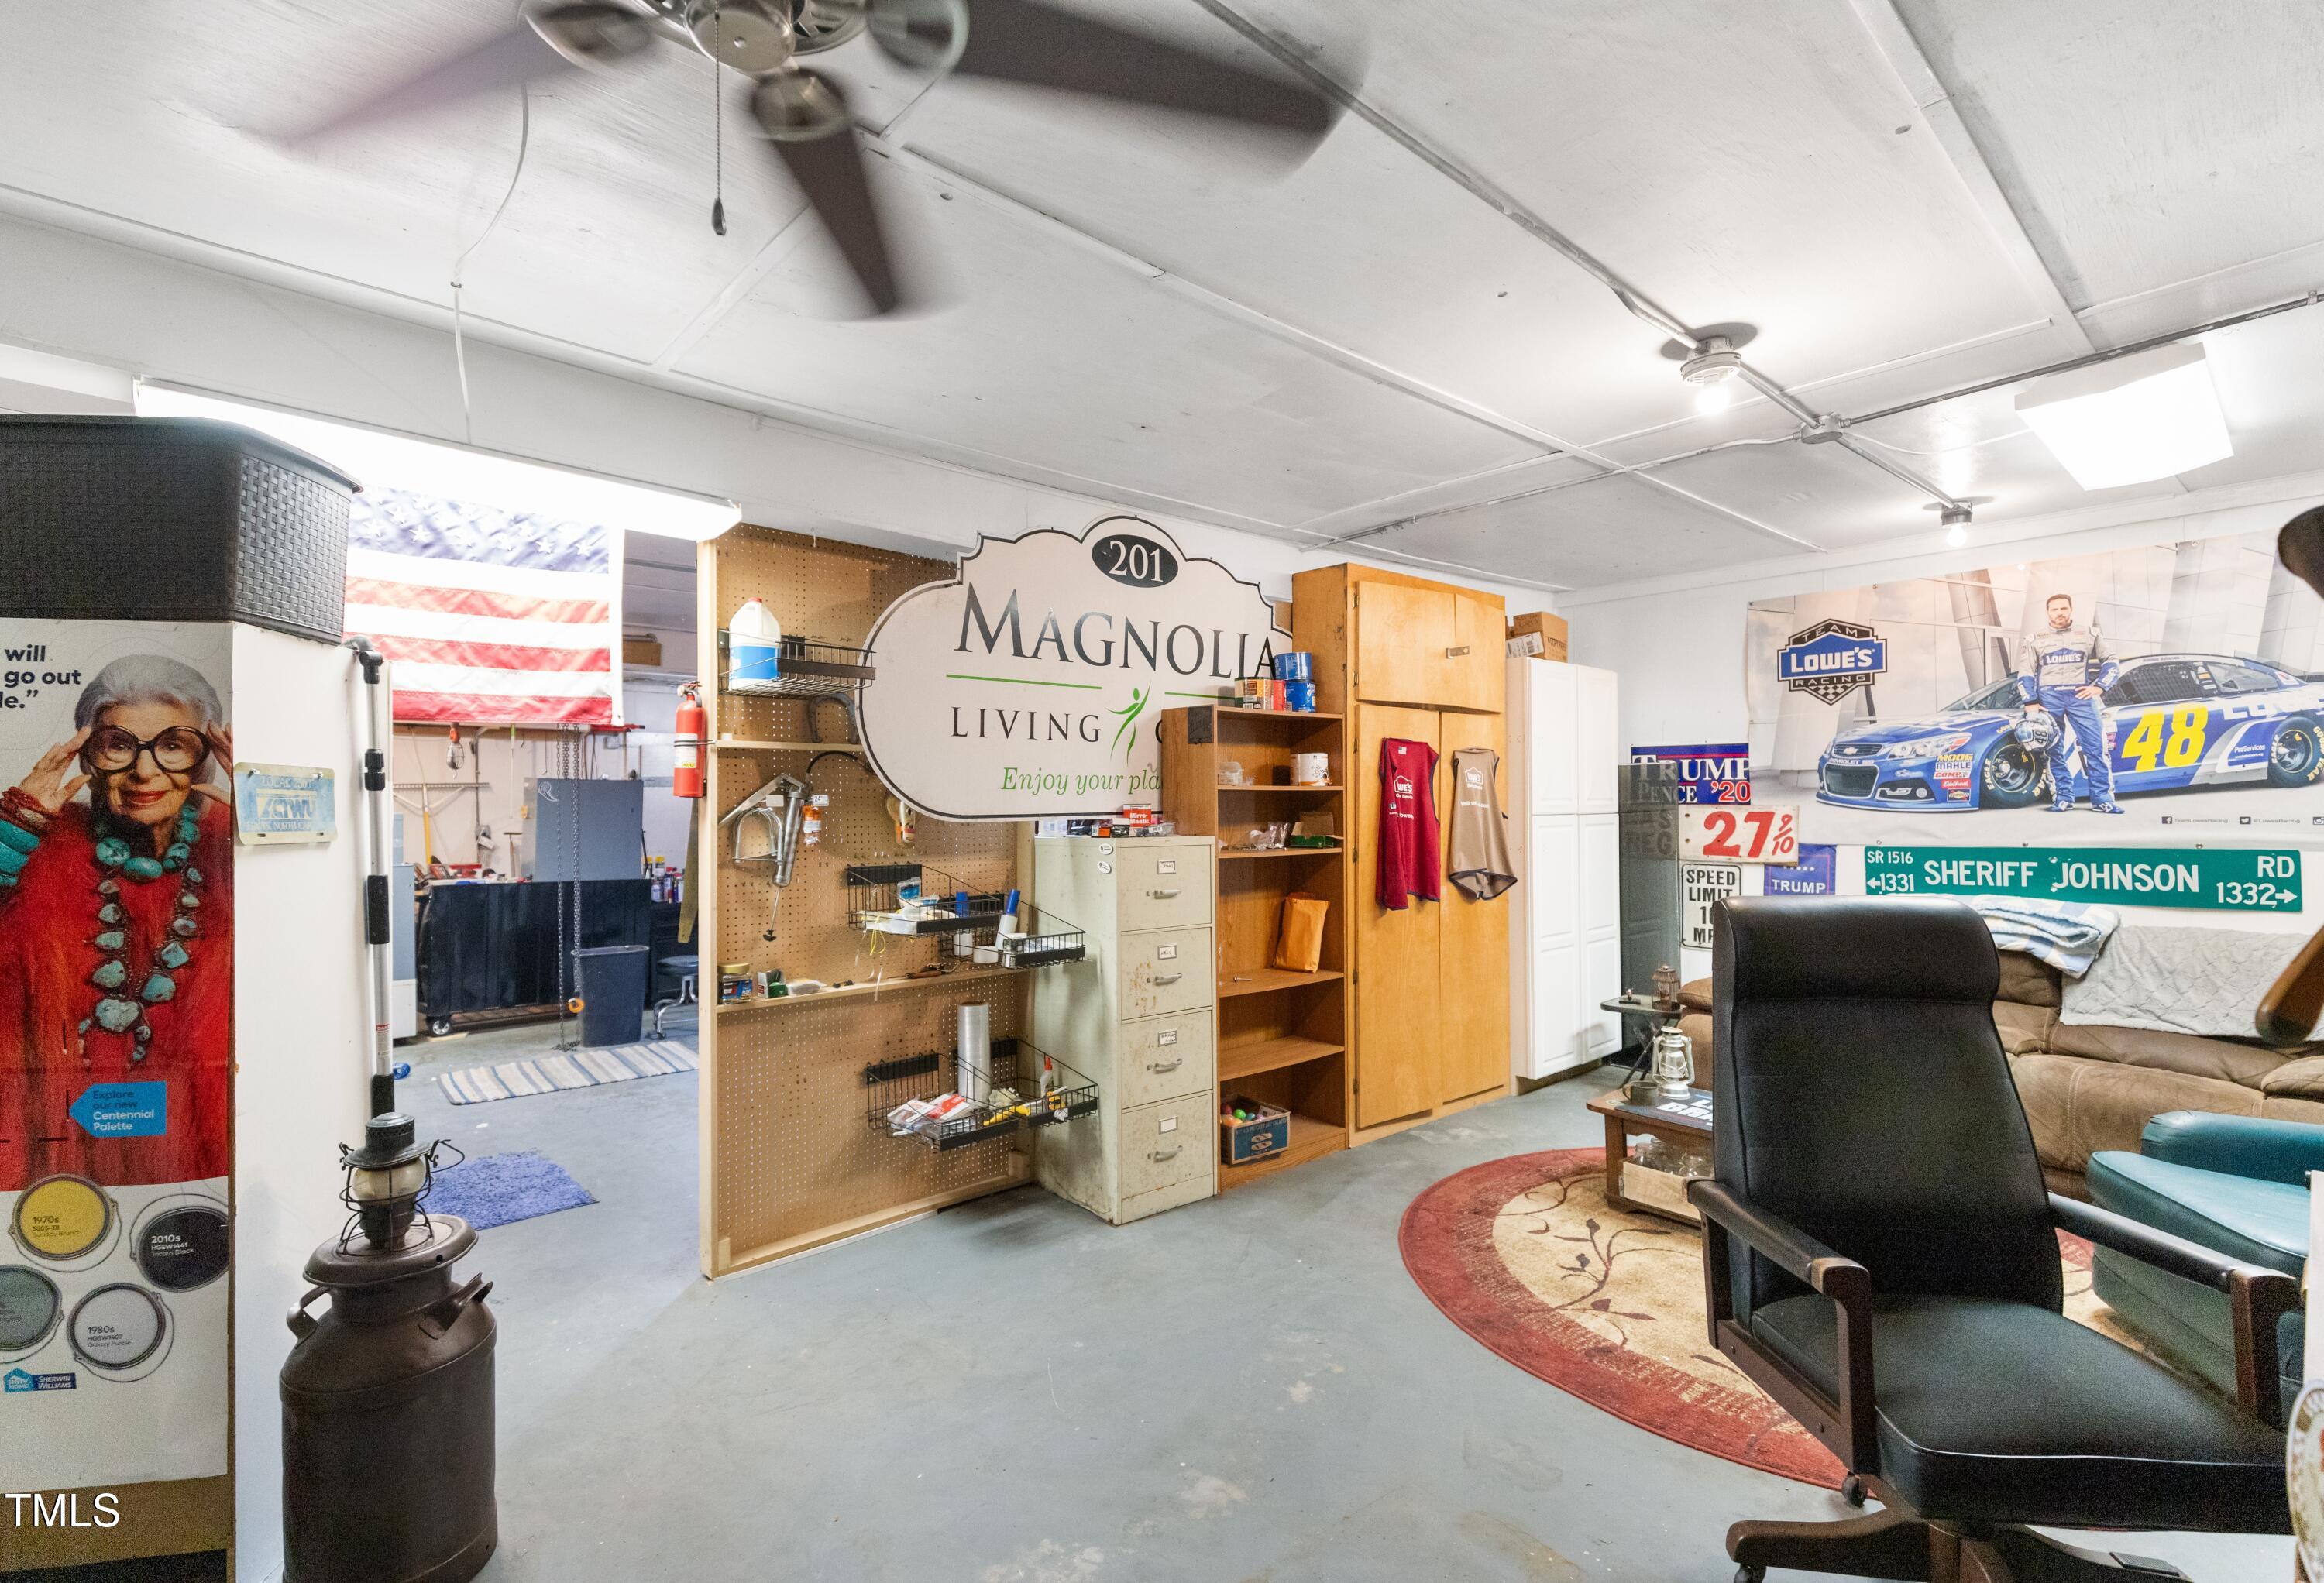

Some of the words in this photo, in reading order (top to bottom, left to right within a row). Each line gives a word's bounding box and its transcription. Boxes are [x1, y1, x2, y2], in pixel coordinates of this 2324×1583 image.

[1109, 540, 1164, 583] 201
[953, 582, 1277, 679] MAGNOLIA
[1801, 624, 1858, 642] TEAM
[5, 644, 46, 662] will
[1790, 646, 1873, 673] LOWE'S
[2045, 652, 2082, 664] LOWE'S
[4, 671, 36, 688] go
[41, 669, 81, 685] out
[1795, 674, 1866, 687] RACING
[951, 706, 1102, 743] LIVING
[2121, 702, 2209, 773] 48
[1631, 755, 1749, 782] TRUMP
[1001, 767, 1068, 795] Enjoy
[1075, 774, 1124, 795] your
[1127, 769, 1163, 795] pla
[1703, 810, 1776, 858] 27
[1866, 850, 1884, 864] SR
[1887, 851, 1913, 865] 1516
[1686, 869, 1736, 886] SPEED
[1880, 873, 1915, 892] 1331
[1923, 860, 2038, 888] SHERIFF
[2054, 862, 2199, 893] JOHNSON
[2257, 856, 2295, 878] RD
[1689, 886, 1733, 902] LIMIT
[1772, 878, 1826, 895] TRUMP
[2216, 881, 2277, 906] 1332
[93, 1090, 135, 1100] Explore
[93, 1109, 154, 1121] Centennial
[93, 1121, 133, 1131] Palette
[32, 1215, 60, 1224] 1970s
[150, 1234, 181, 1244] 2010s
[87, 1325, 115, 1334] 1980s
